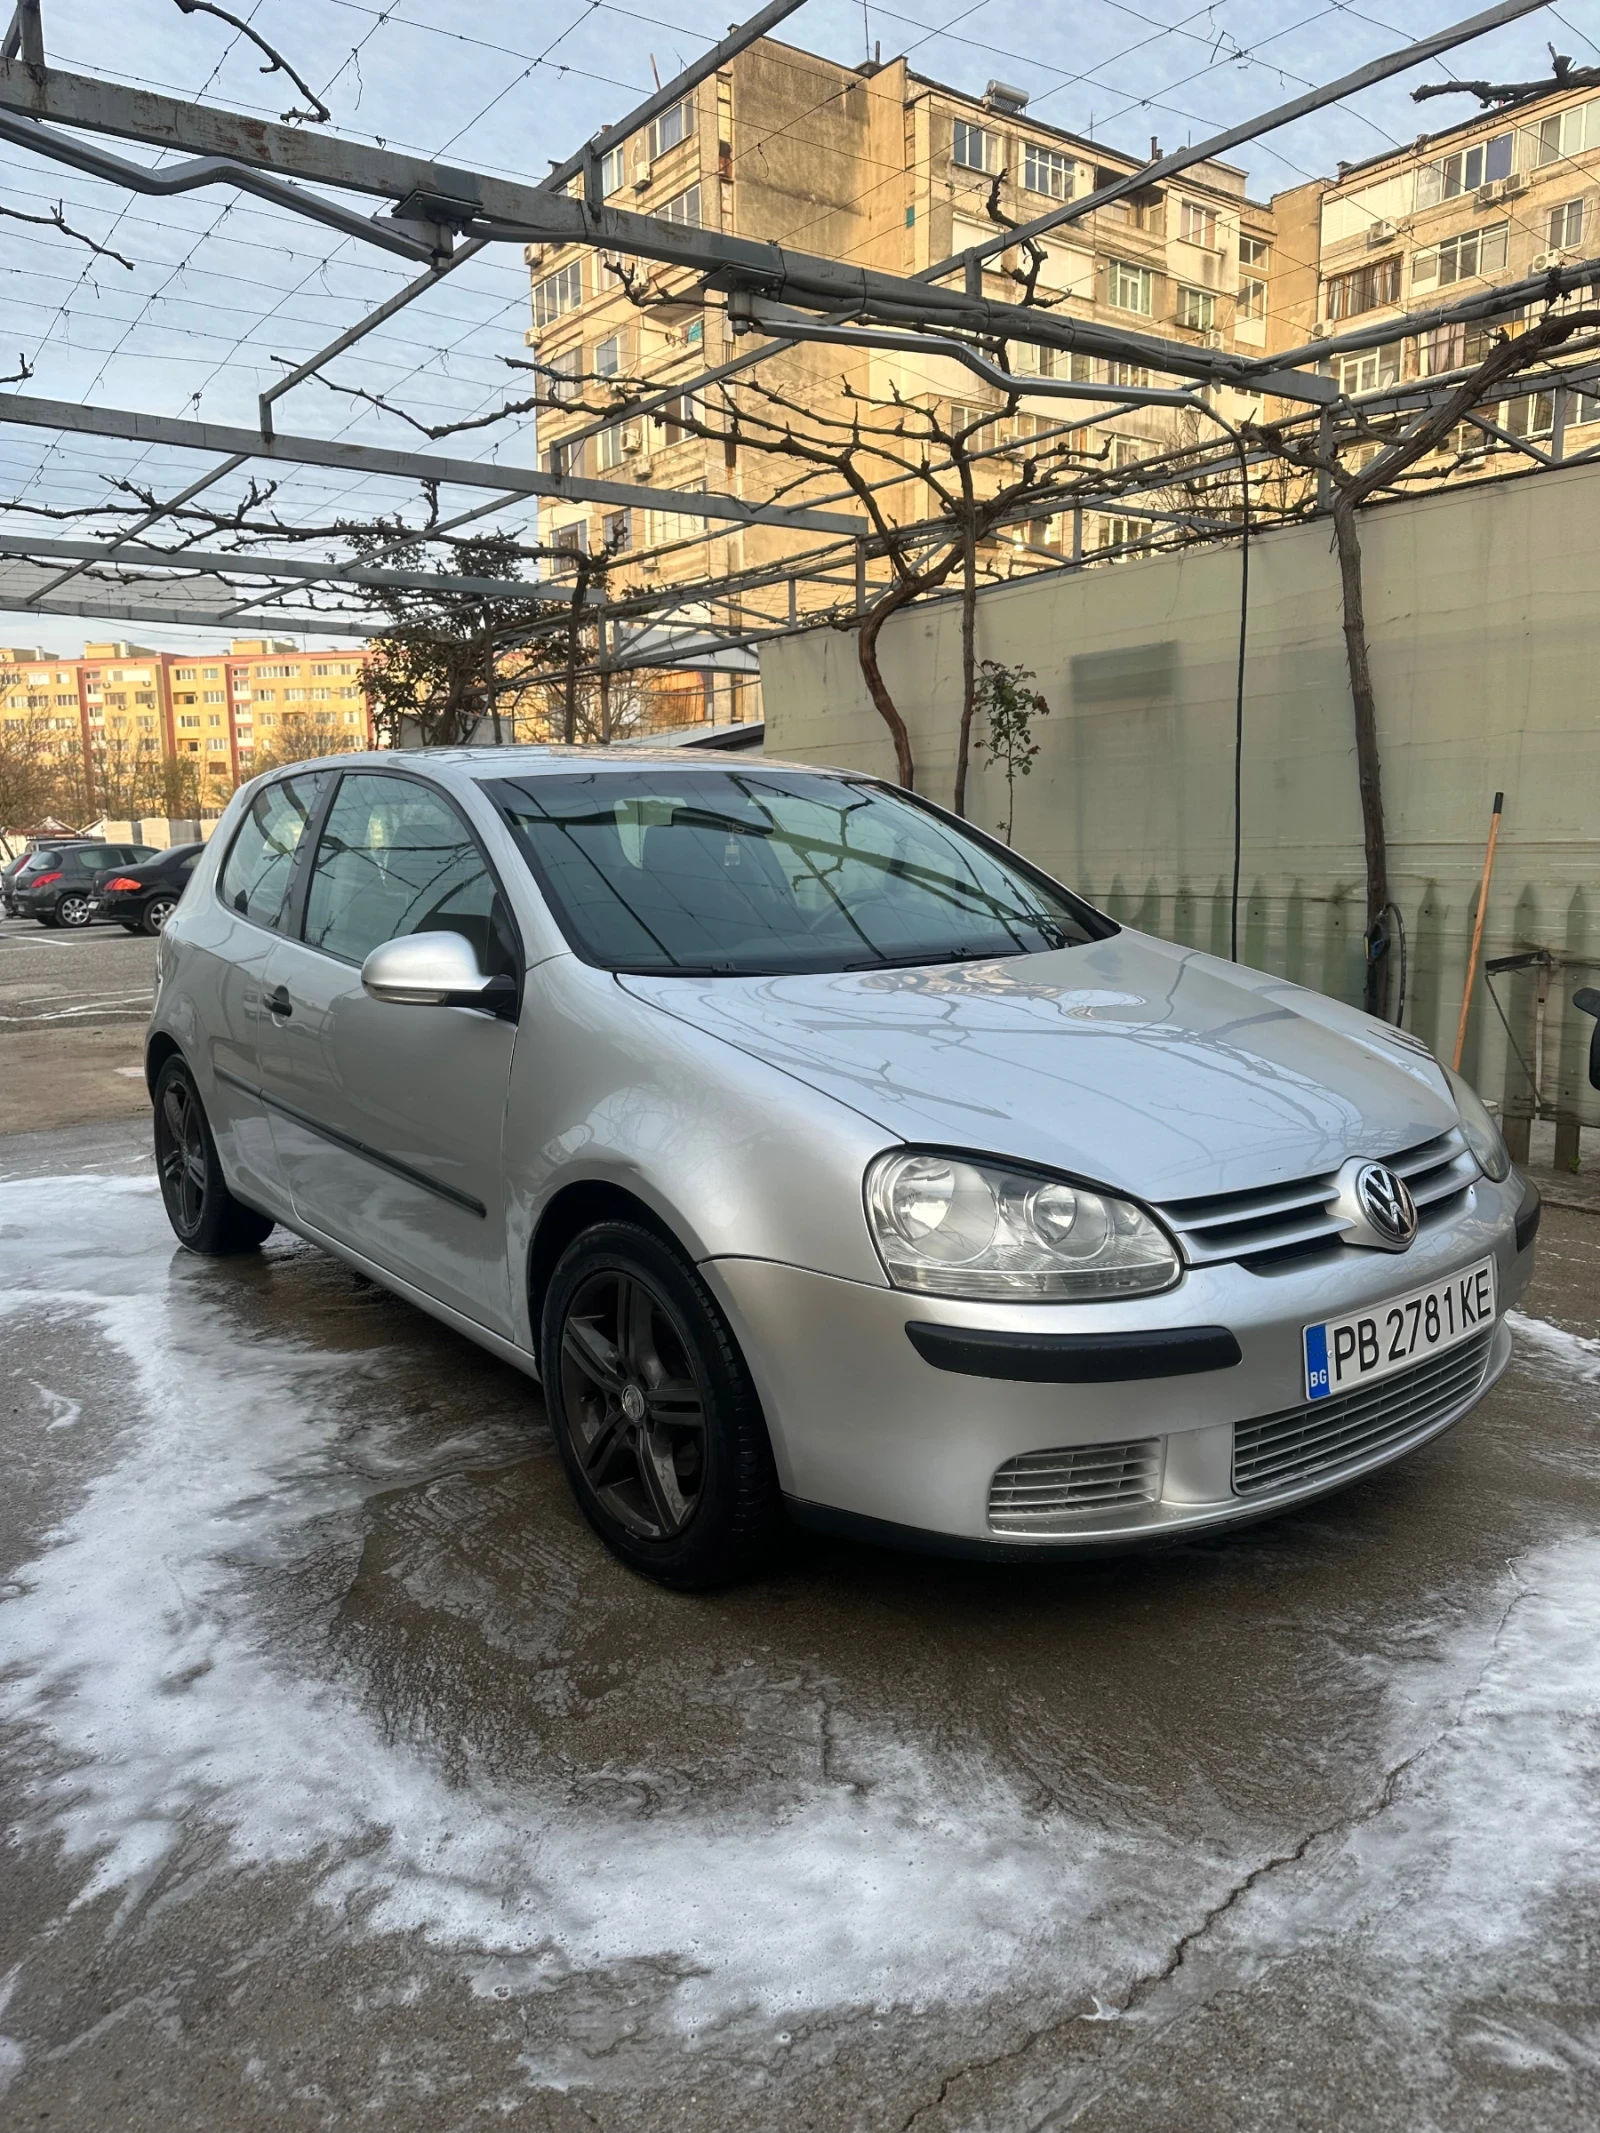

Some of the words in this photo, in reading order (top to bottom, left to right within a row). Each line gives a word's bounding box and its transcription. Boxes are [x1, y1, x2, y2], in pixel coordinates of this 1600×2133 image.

[1333, 1318, 1380, 1381] PB
[1385, 1285, 1455, 1362] 2781
[1459, 1268, 1492, 1329] KE
[1309, 1368, 1328, 1388] BG
